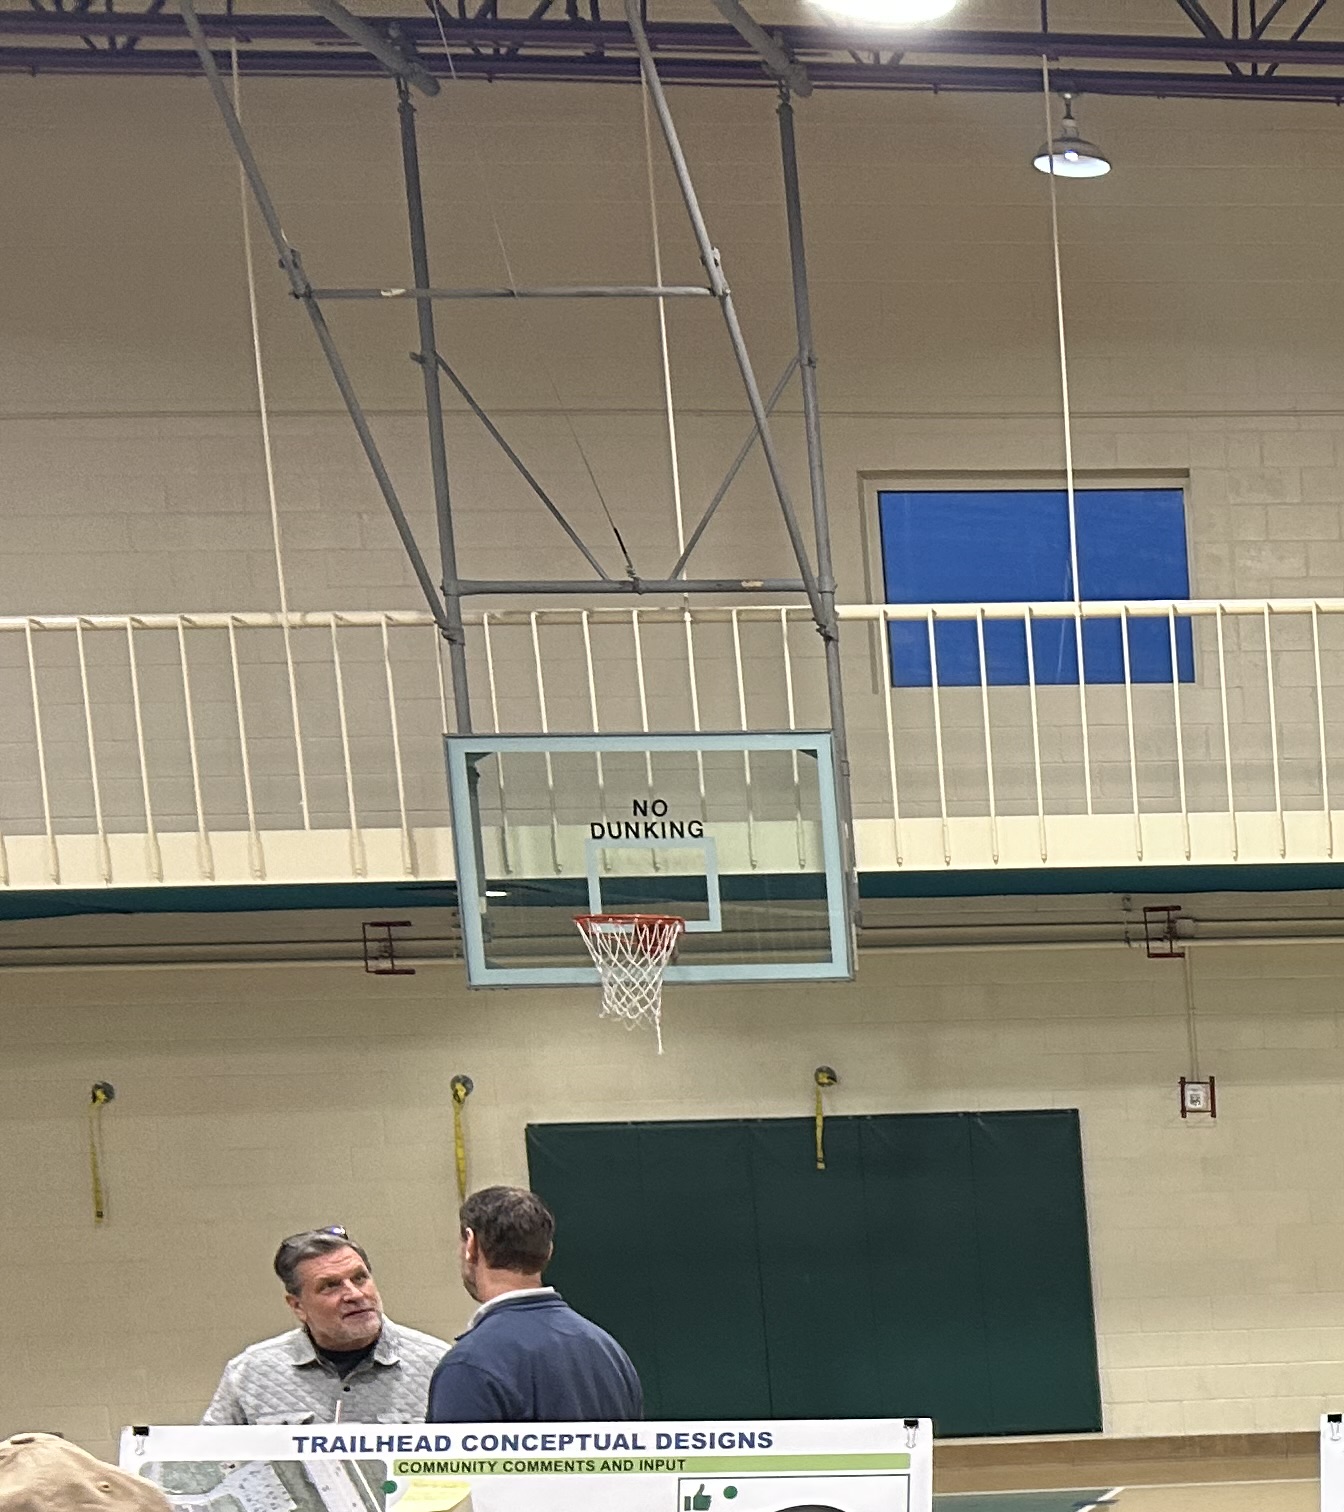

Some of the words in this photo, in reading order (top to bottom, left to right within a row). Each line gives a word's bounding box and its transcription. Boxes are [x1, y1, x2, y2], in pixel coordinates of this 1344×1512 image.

[633, 799, 668, 817] NO
[590, 820, 704, 840] DUNKING
[292, 1434, 452, 1454] TRAILHEAD
[460, 1432, 647, 1453] CONCEPTUAL
[655, 1431, 774, 1450] DESIGNS
[397, 1460, 498, 1474] COMMUNITY
[502, 1459, 596, 1473] COMMENTS
[600, 1459, 635, 1472] AND
[639, 1458, 687, 1472] INPUT
